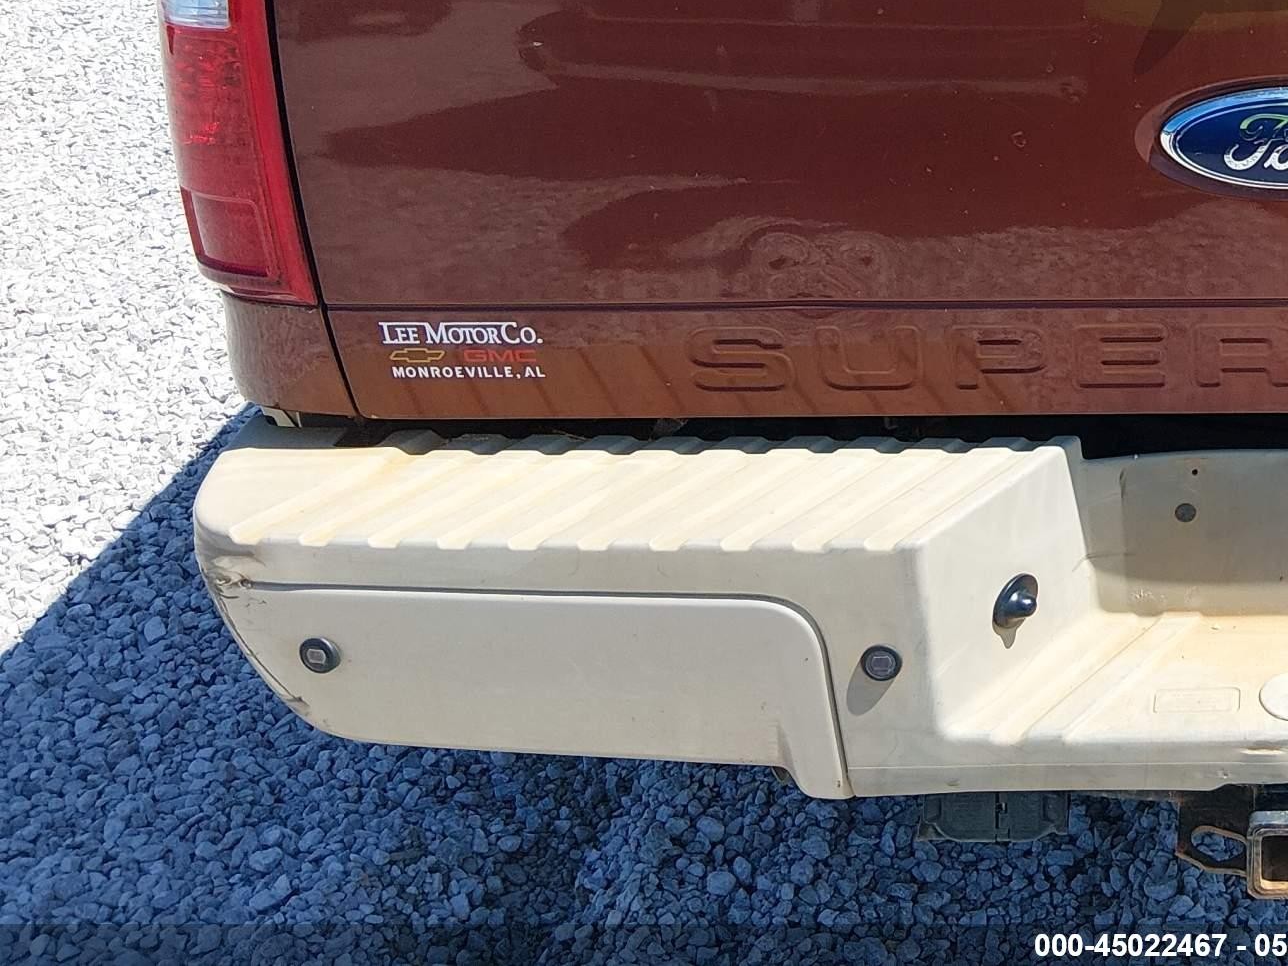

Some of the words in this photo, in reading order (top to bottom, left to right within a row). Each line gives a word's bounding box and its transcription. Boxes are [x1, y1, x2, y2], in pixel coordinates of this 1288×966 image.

[378, 321, 421, 344] LEE
[463, 348, 537, 363] GMC
[392, 366, 521, 379] MONROEVILLE,
[524, 366, 546, 378] AL
